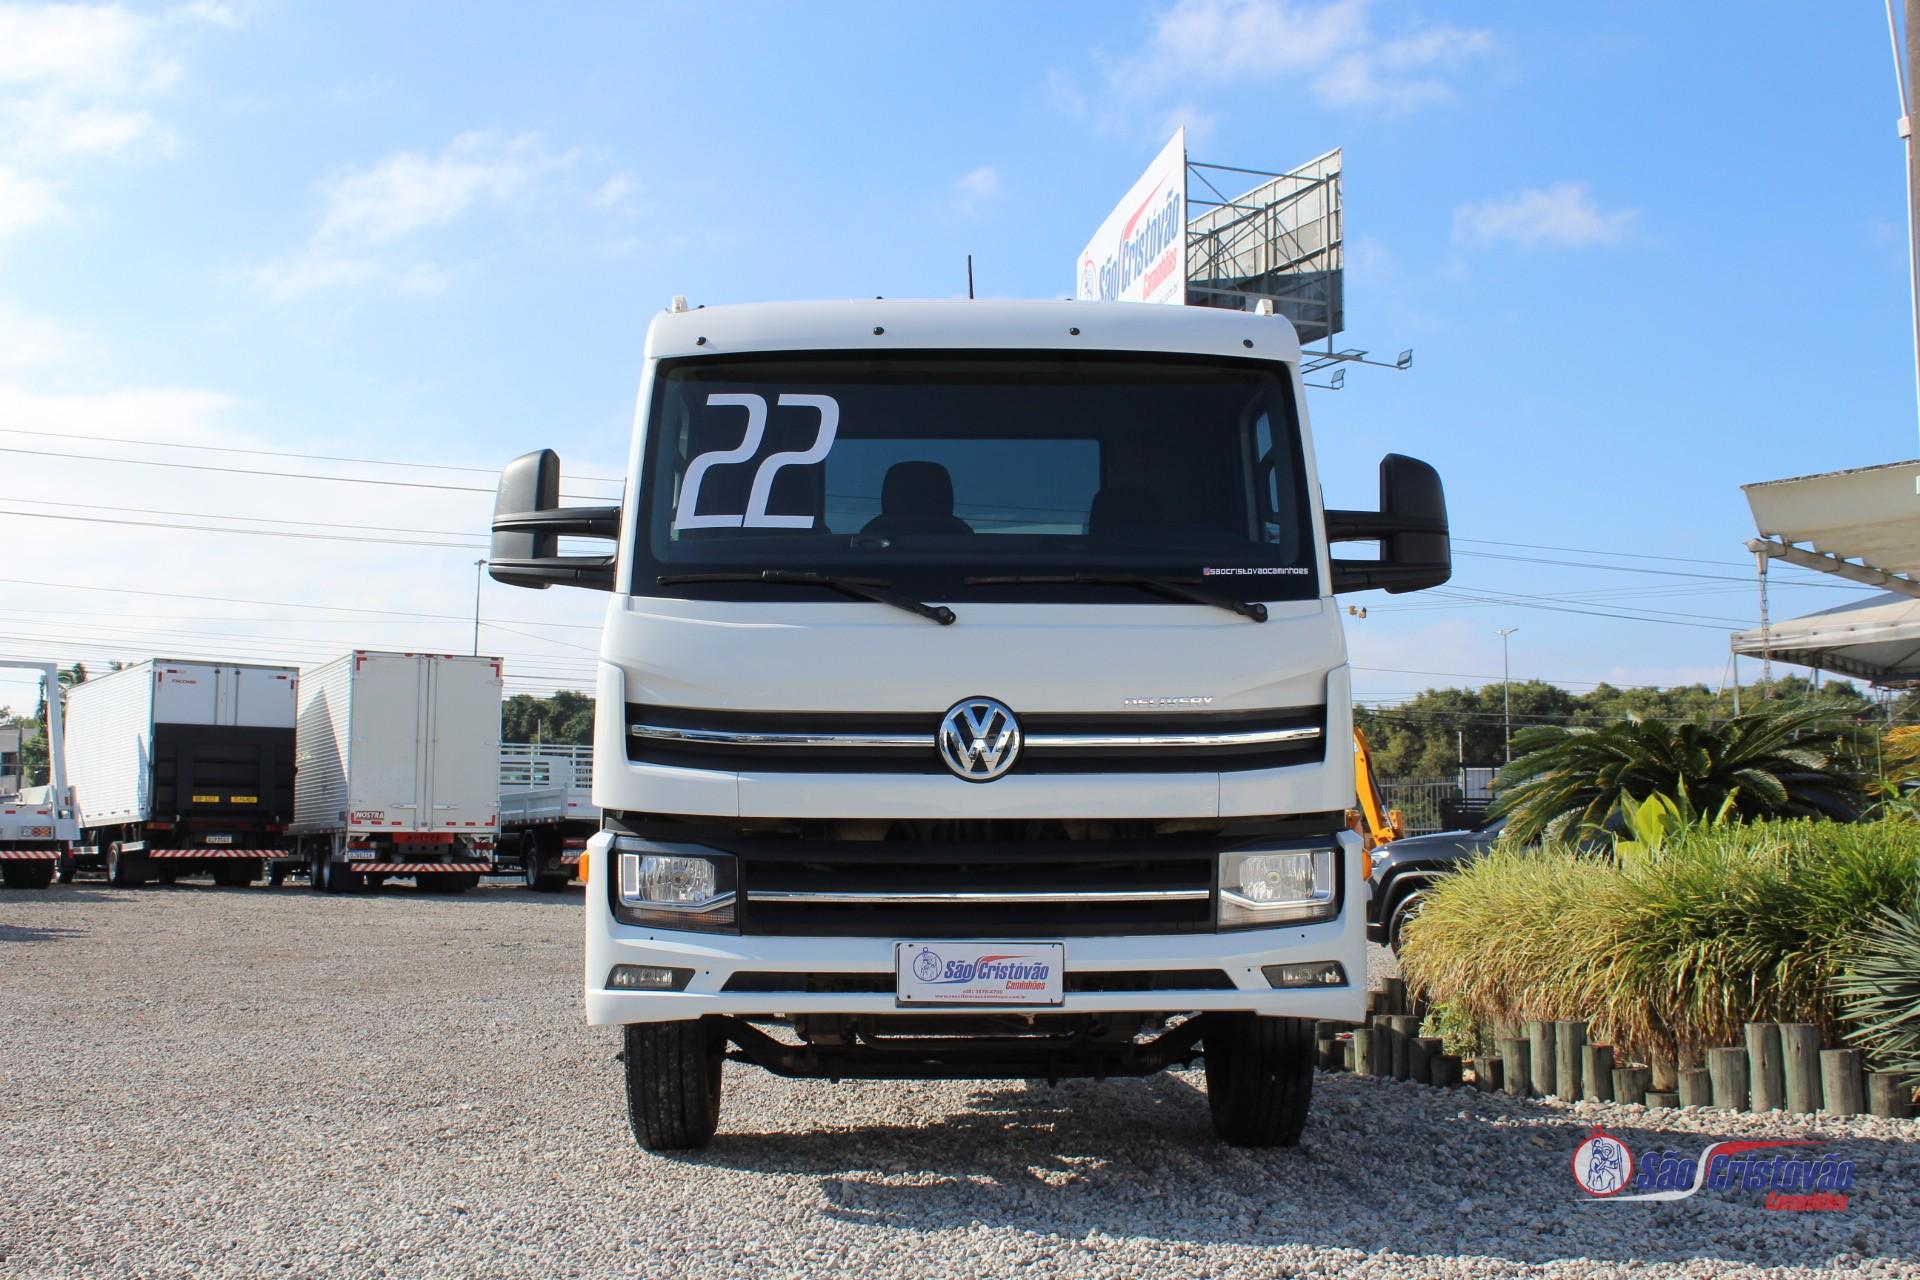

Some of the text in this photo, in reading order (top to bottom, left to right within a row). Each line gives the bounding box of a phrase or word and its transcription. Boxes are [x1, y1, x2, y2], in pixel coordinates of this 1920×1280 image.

[1121, 186, 1180, 293] Cristóvão
[674, 393, 840, 530] 22
[355, 811, 384, 820] NOSTRA
[944, 960, 1050, 980] São Cristóvão
[1006, 981, 1046, 990] Caminhões
